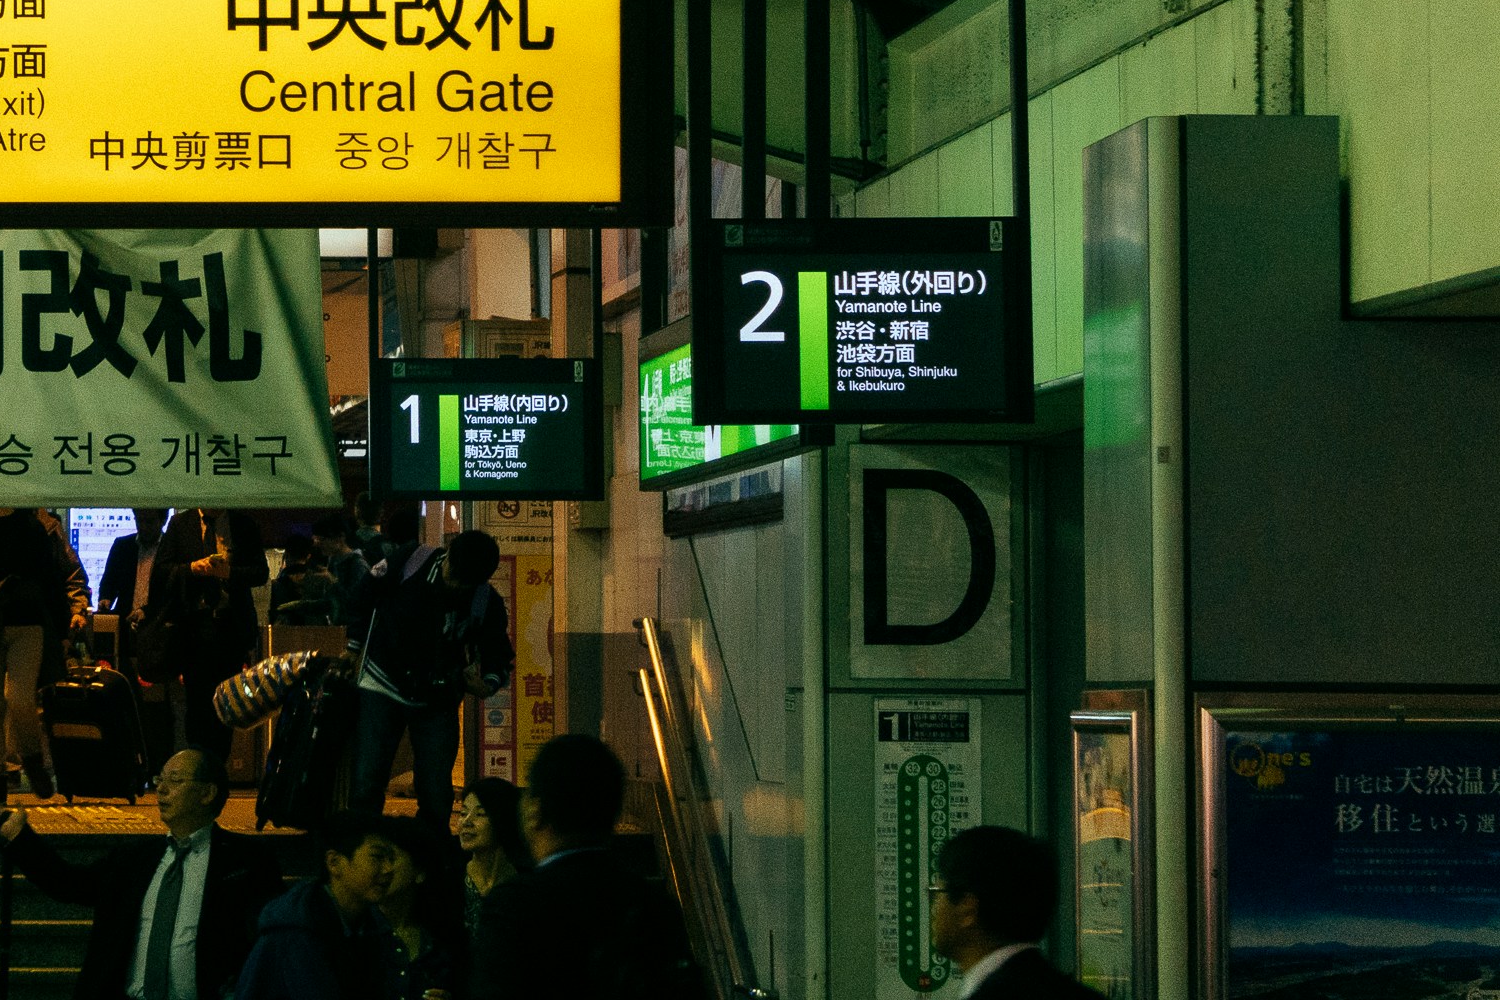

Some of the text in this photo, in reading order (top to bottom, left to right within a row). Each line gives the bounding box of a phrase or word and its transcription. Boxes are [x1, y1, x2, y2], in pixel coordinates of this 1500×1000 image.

[239, 69, 554, 113] Central Gate
[89, 130, 292, 171] 中央剪票口
[335, 131, 557, 171] 중앙 개찰구
[834, 269, 987, 296] 山手線(外回り)
[739, 270, 785, 342] 2
[835, 299, 942, 314] Yamanote Line
[835, 320, 930, 341] 渋谷・新宿
[836, 343, 915, 364] 池袋方面
[836, 365, 958, 380] for Shibuya, Shinjuku
[836, 380, 906, 392] & Ikebukuro
[463, 394, 569, 413] 山手線(内回り)
[400, 394, 420, 444] 1
[464, 414, 538, 425] Yamanote Line
[464, 428, 526, 444] 東京・上野
[52, 431, 141, 477] 전용
[161, 429, 294, 478] 개찰구
[464, 444, 519, 459] 駒込方面
[464, 460, 476, 469] for
[505, 460, 527, 469] Ueno
[464, 469, 519, 480] & Komagome
[863, 468, 996, 646] D
[884, 714, 899, 740] 1
